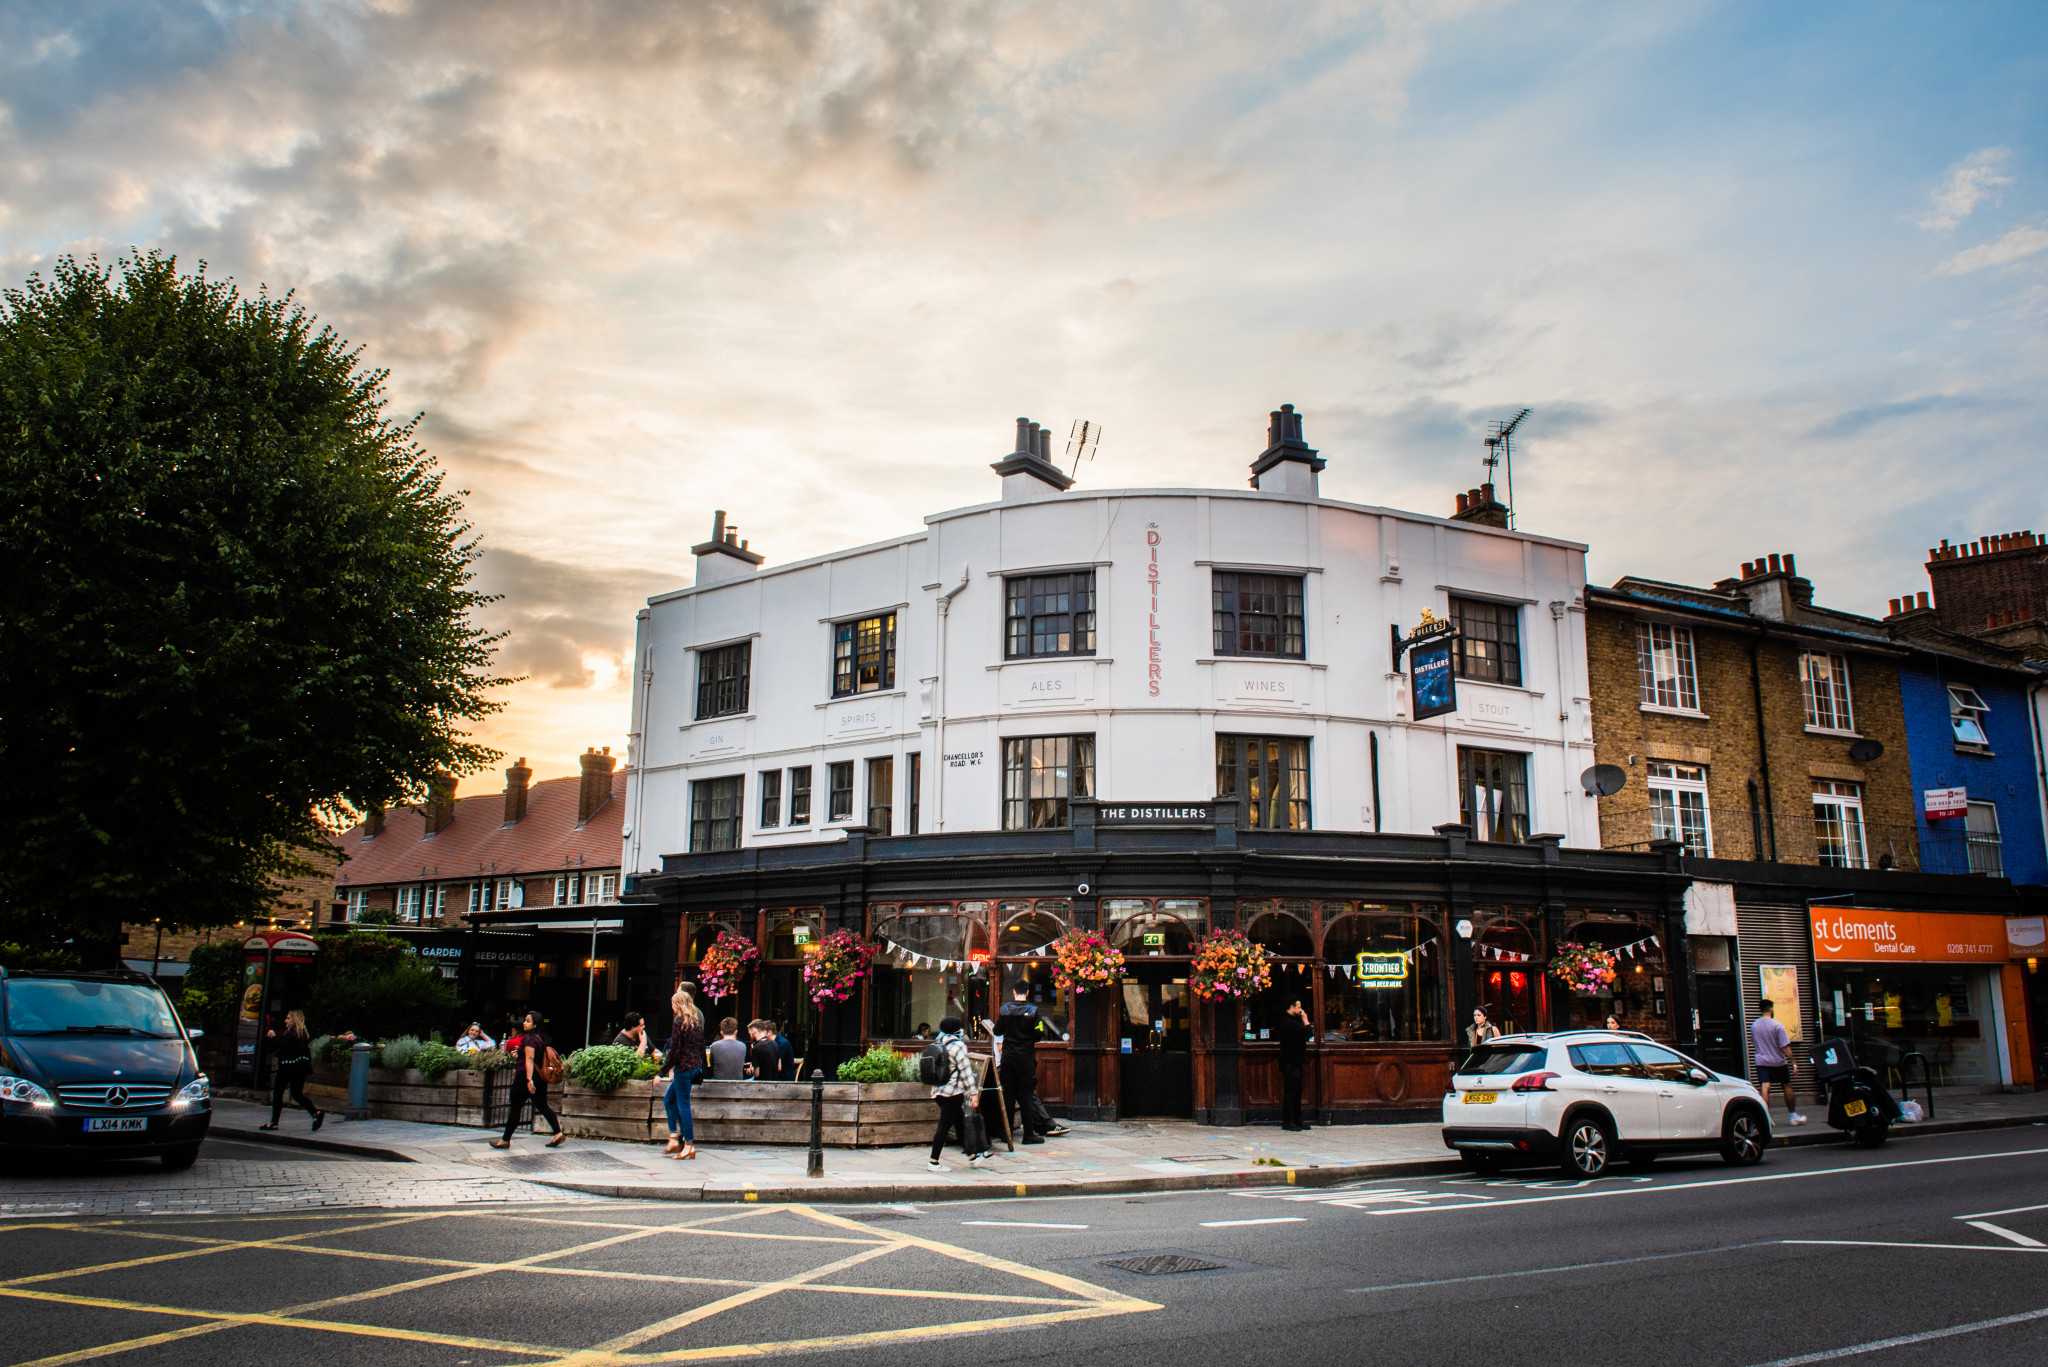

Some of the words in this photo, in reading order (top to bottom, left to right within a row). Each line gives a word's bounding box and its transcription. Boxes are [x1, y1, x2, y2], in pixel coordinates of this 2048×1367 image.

[1147, 530, 1162, 697] DISTILLERS
[1414, 658, 1449, 674] DISTILLERS
[1031, 680, 1062, 691] ALES
[1244, 680, 1286, 692] WINES
[1478, 703, 1511, 716] STOUT
[841, 713, 877, 726] SPIRITS
[709, 734, 725, 746] GIN
[950, 760, 966, 768] ROAD
[1101, 808, 1126, 819] THE
[1131, 808, 1207, 819] DISTILLERS
[1815, 918, 1829, 939] st
[1832, 916, 1897, 941] clements
[421, 946, 462, 958] GARDEN
[1874, 942, 1898, 953] Dental
[1899, 943, 1917, 954] Care
[475, 951, 498, 961] BEER
[499, 951, 535, 962] GARDEN
[1364, 962, 1400, 974] FRONTIER
